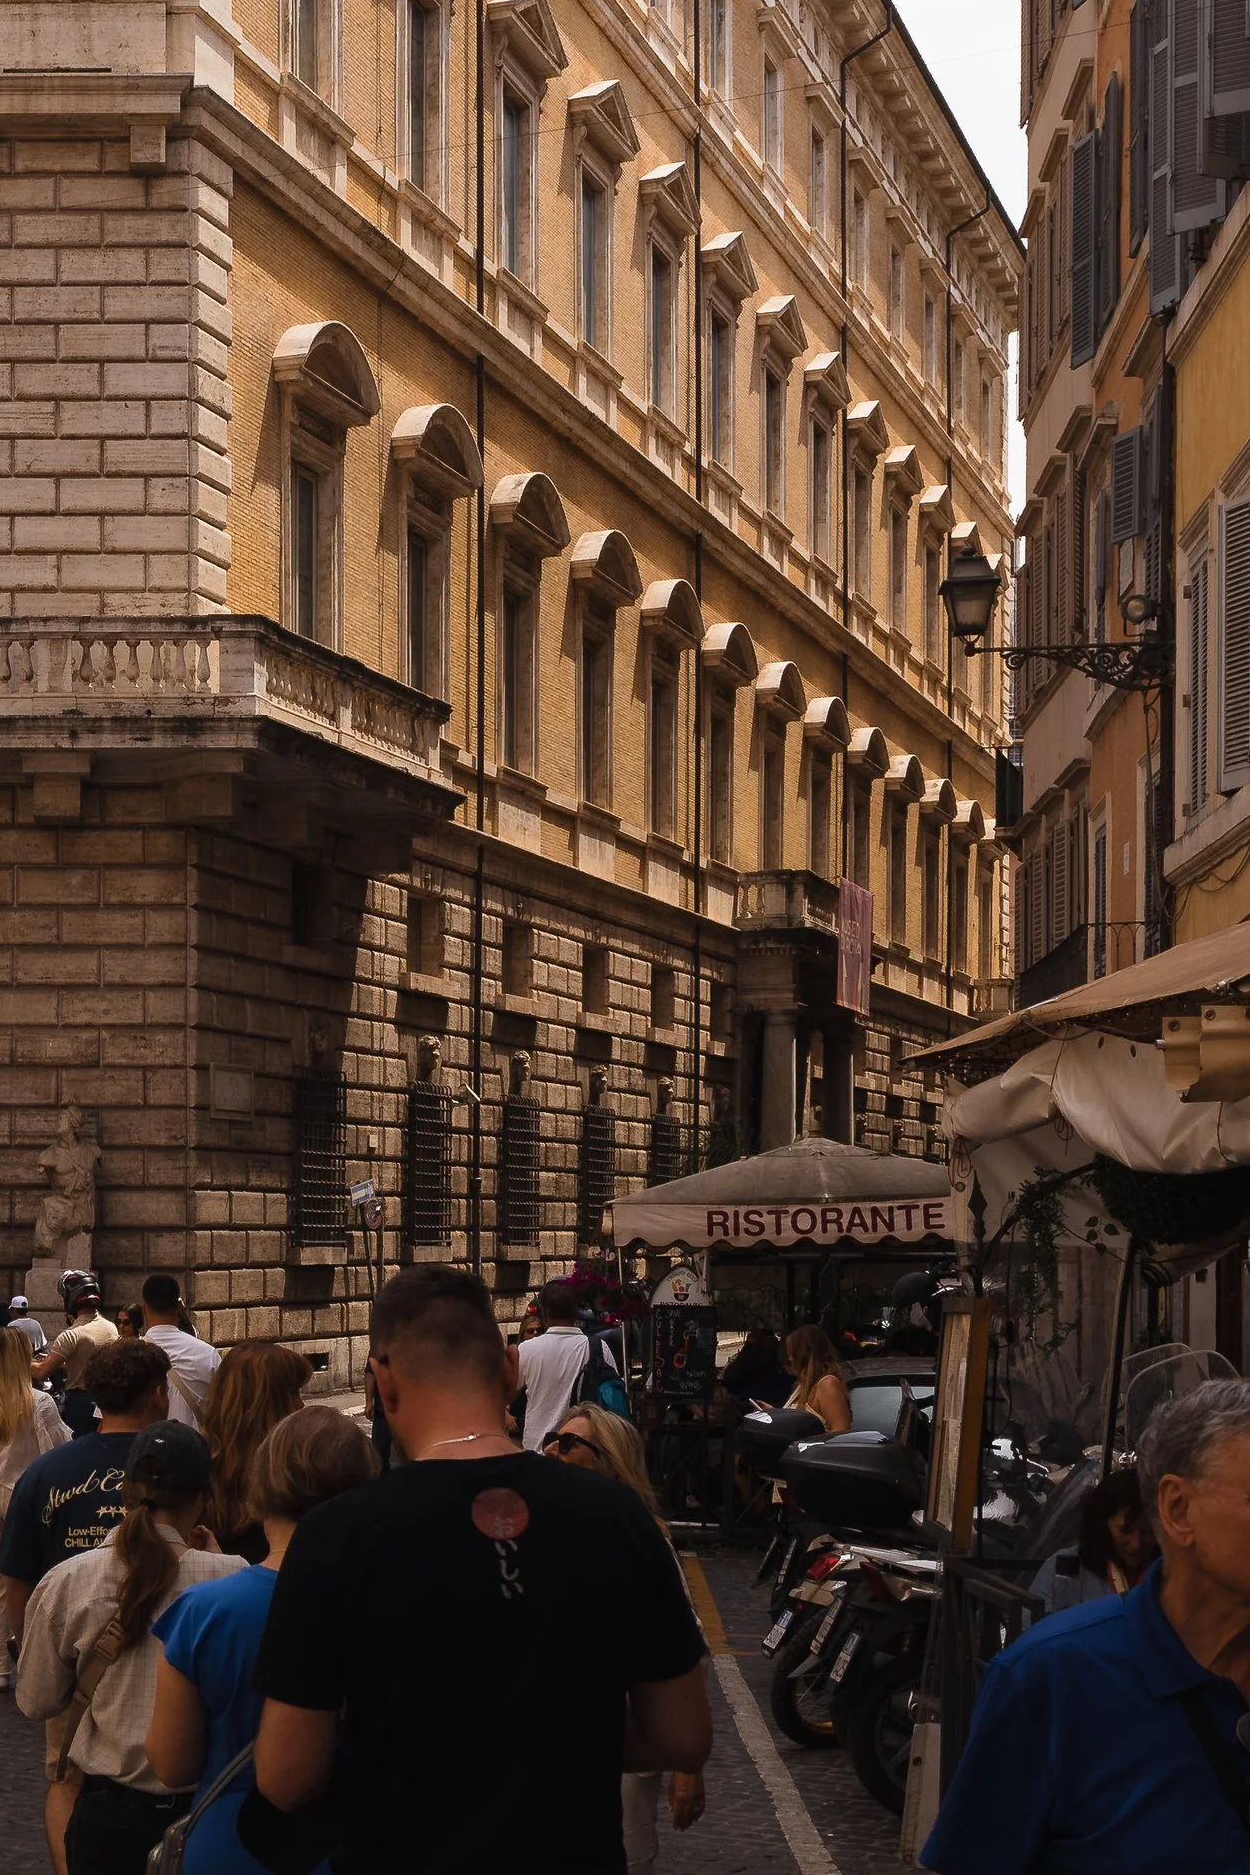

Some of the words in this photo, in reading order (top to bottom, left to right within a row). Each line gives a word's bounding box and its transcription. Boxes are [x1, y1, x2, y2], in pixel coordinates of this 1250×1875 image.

[706, 1202, 946, 1238] RISTORANTE
[69, 1526, 111, 1537] Low-Effo
[64, 1538, 91, 1548] CHILL
